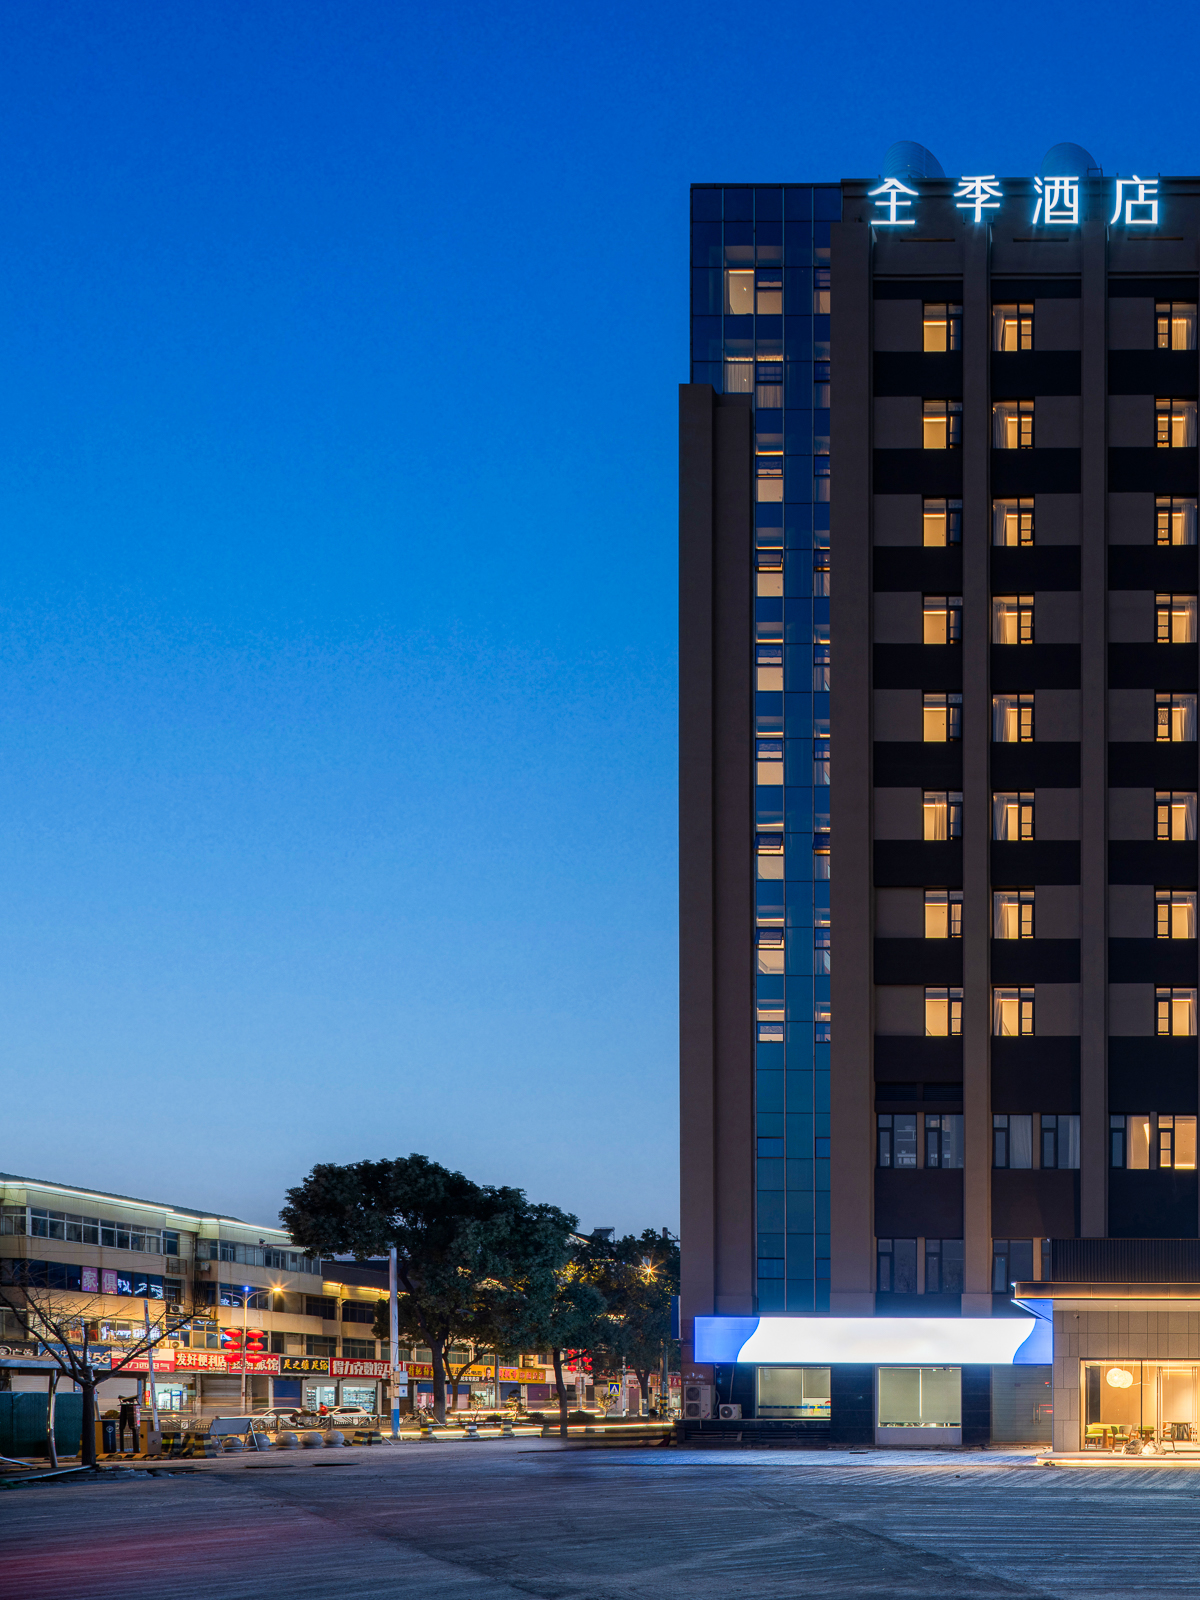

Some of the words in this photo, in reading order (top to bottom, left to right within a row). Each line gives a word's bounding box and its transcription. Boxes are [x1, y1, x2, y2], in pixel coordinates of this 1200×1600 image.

[867, 174, 1159, 225] 全季酒店
[92, 1352, 111, 1364] 5G
[176, 1353, 227, 1368] 发好便利店
